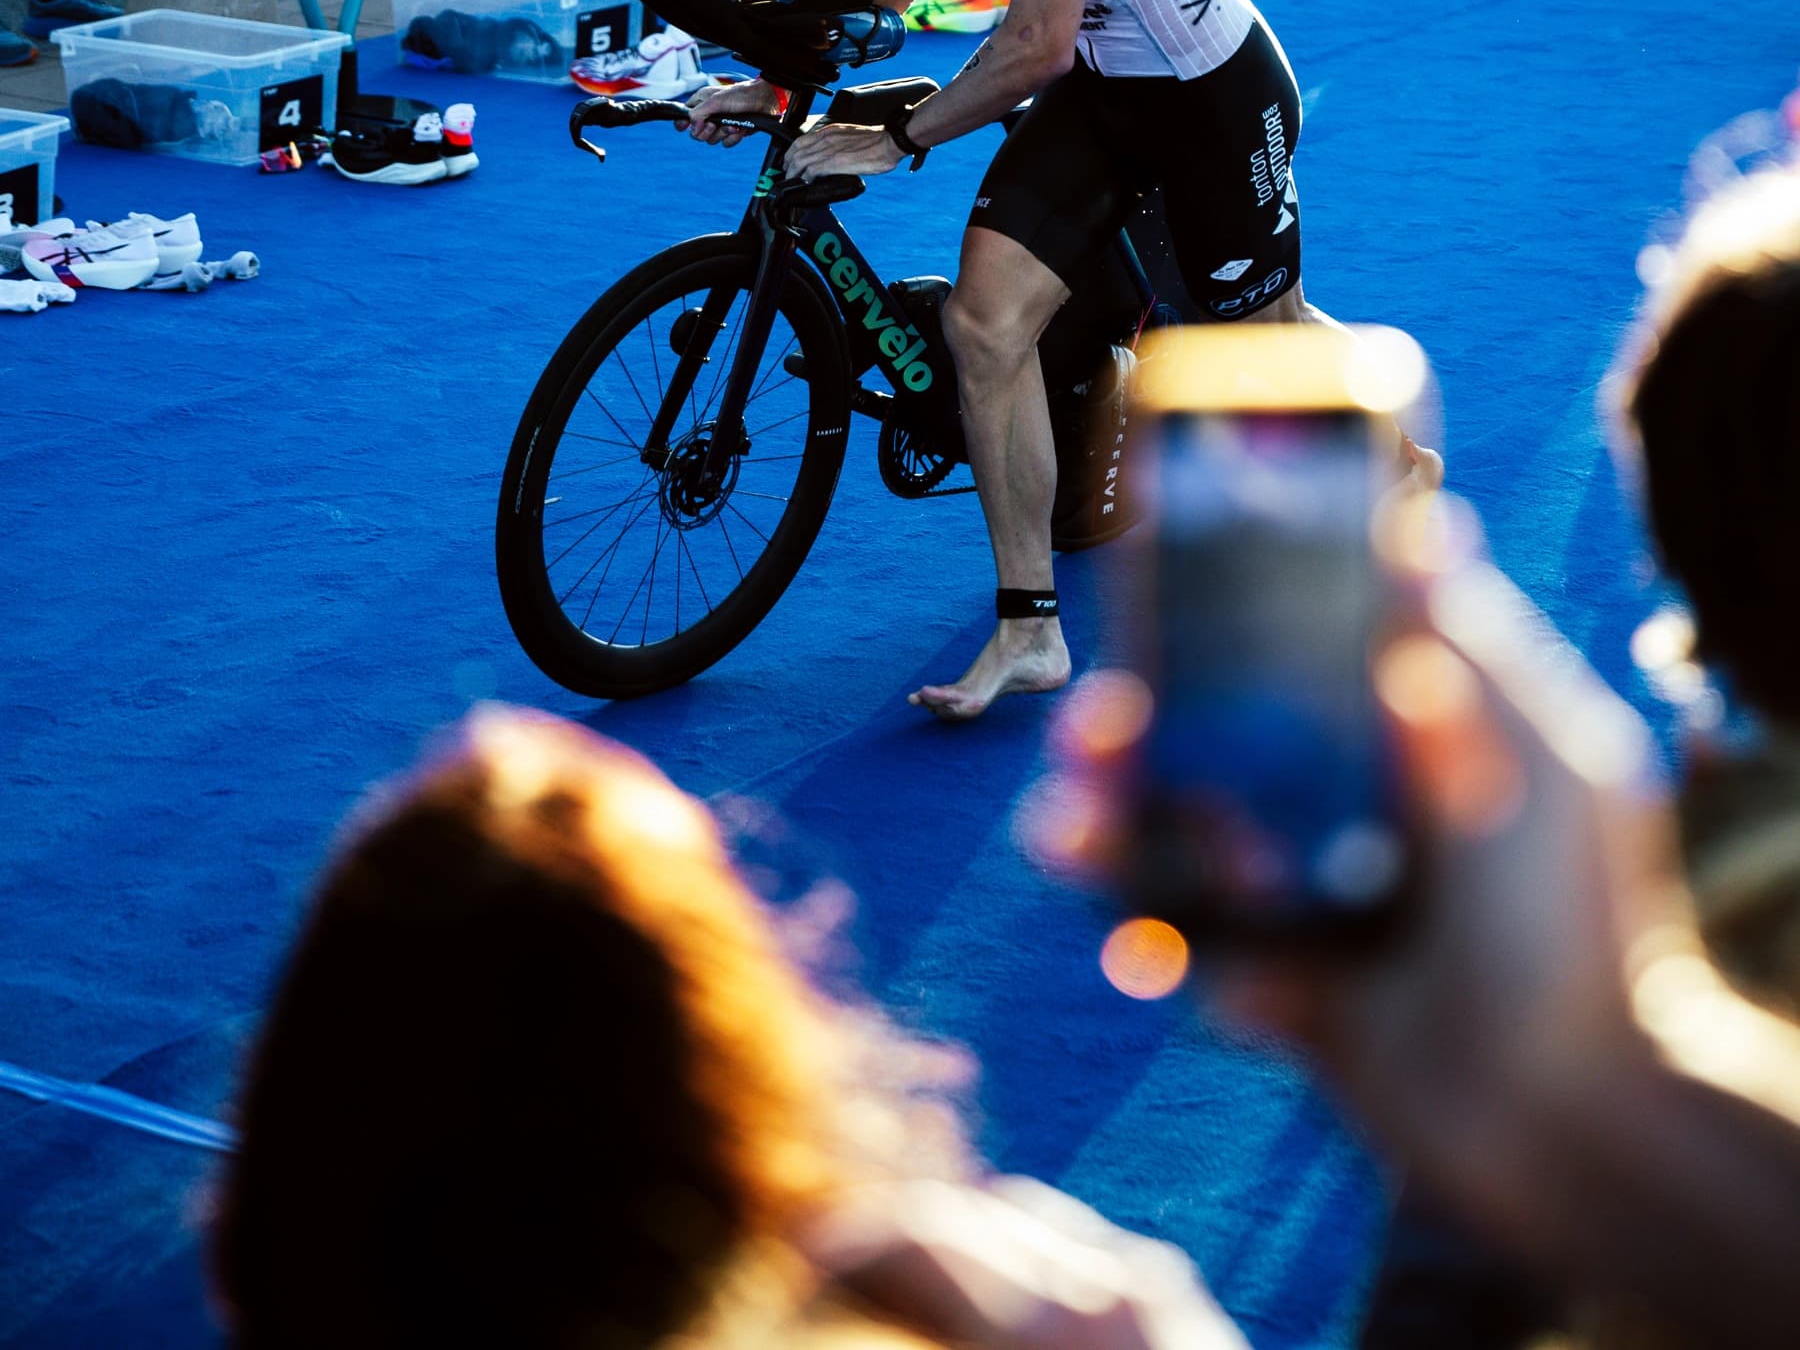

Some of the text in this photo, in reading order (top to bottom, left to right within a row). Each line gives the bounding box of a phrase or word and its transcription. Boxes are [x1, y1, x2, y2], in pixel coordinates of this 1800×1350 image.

[591, 24, 612, 54] 5
[277, 98, 302, 128] 4
[813, 231, 934, 393] cervélo
